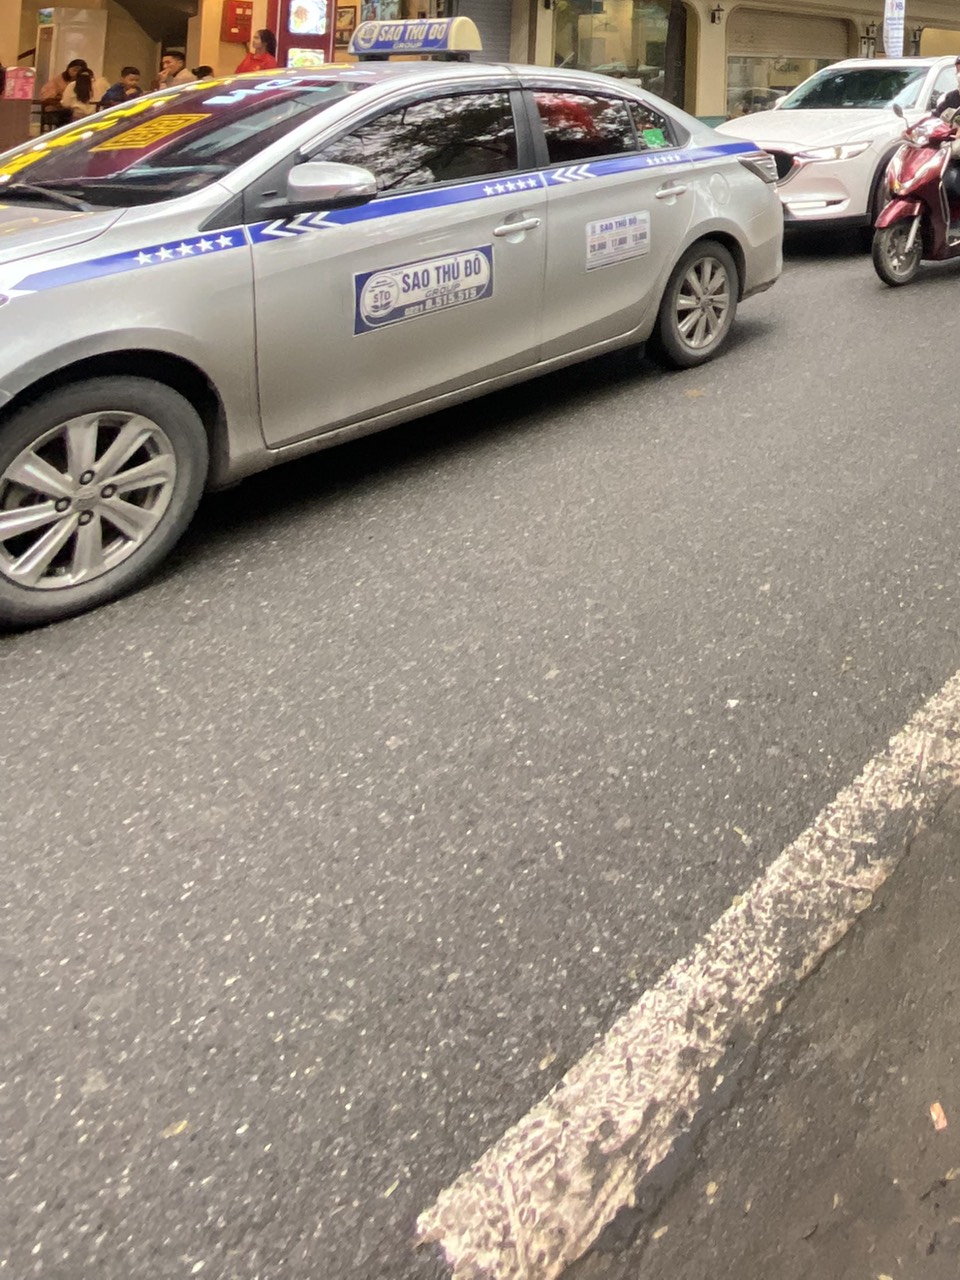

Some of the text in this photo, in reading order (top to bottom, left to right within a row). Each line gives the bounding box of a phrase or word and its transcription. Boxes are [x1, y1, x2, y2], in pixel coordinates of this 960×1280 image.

[379, 25, 403, 42] SAO
[600, 222, 614, 233] SAO
[401, 252, 482, 294] SAO THỦ ĐÔ
[373, 289, 391, 304] STD
[425, 282, 462, 298] GROUP
